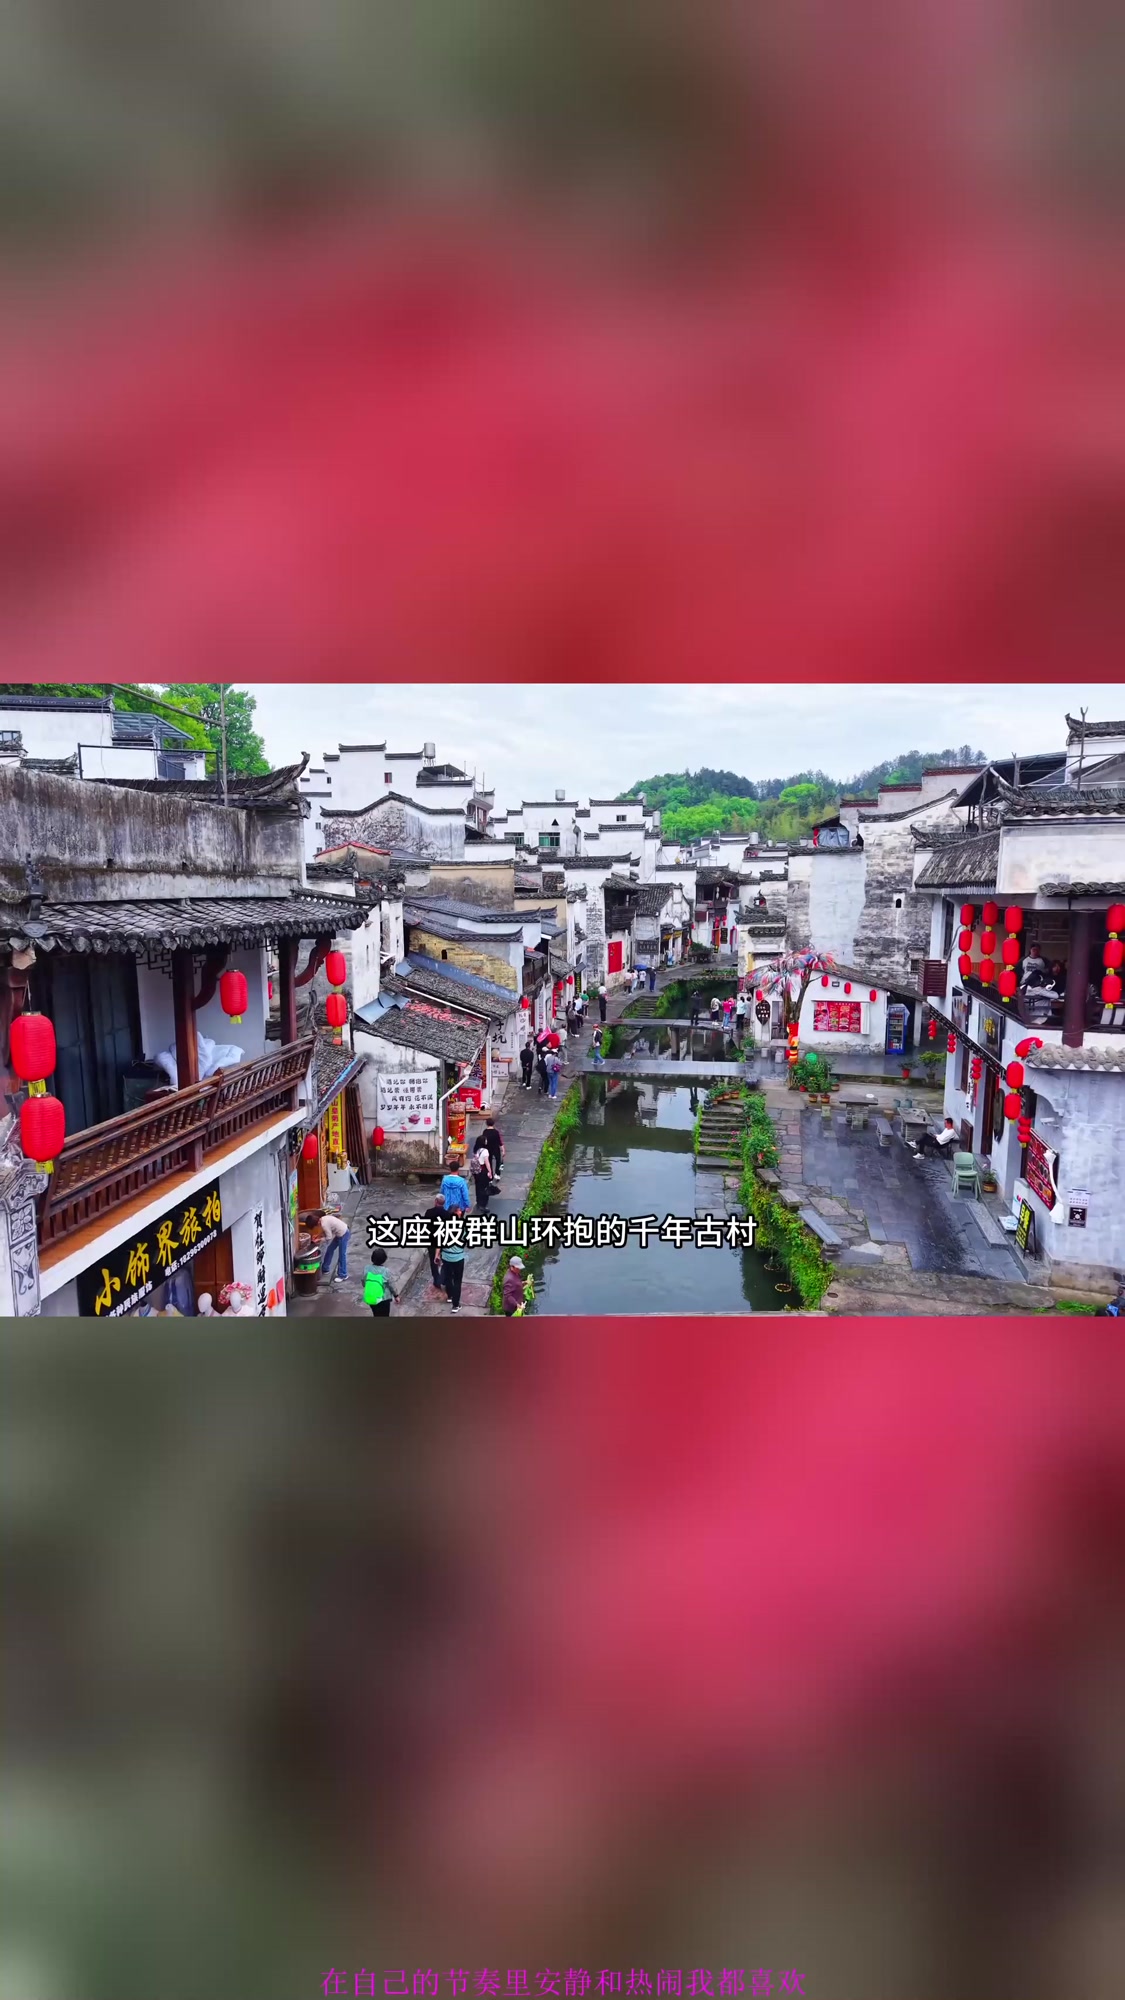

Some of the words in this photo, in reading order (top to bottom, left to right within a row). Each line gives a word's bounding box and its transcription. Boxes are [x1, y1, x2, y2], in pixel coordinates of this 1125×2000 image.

[106, 1280, 153, 1317] 各种民族服饰
